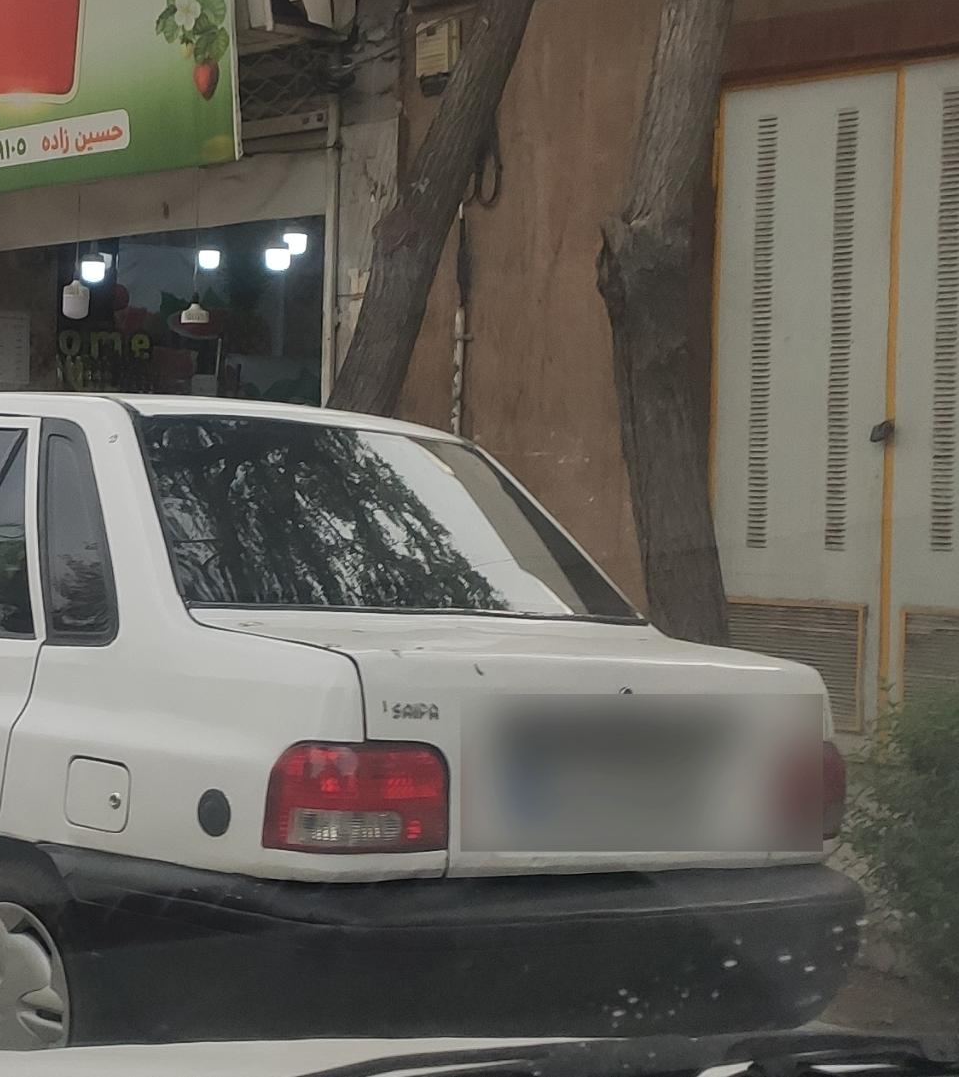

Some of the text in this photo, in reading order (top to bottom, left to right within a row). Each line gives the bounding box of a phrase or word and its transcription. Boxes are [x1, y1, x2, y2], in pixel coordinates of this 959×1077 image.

[42, 125, 123, 154] حسین زاده
[392, 703, 439, 720] SAIPA
